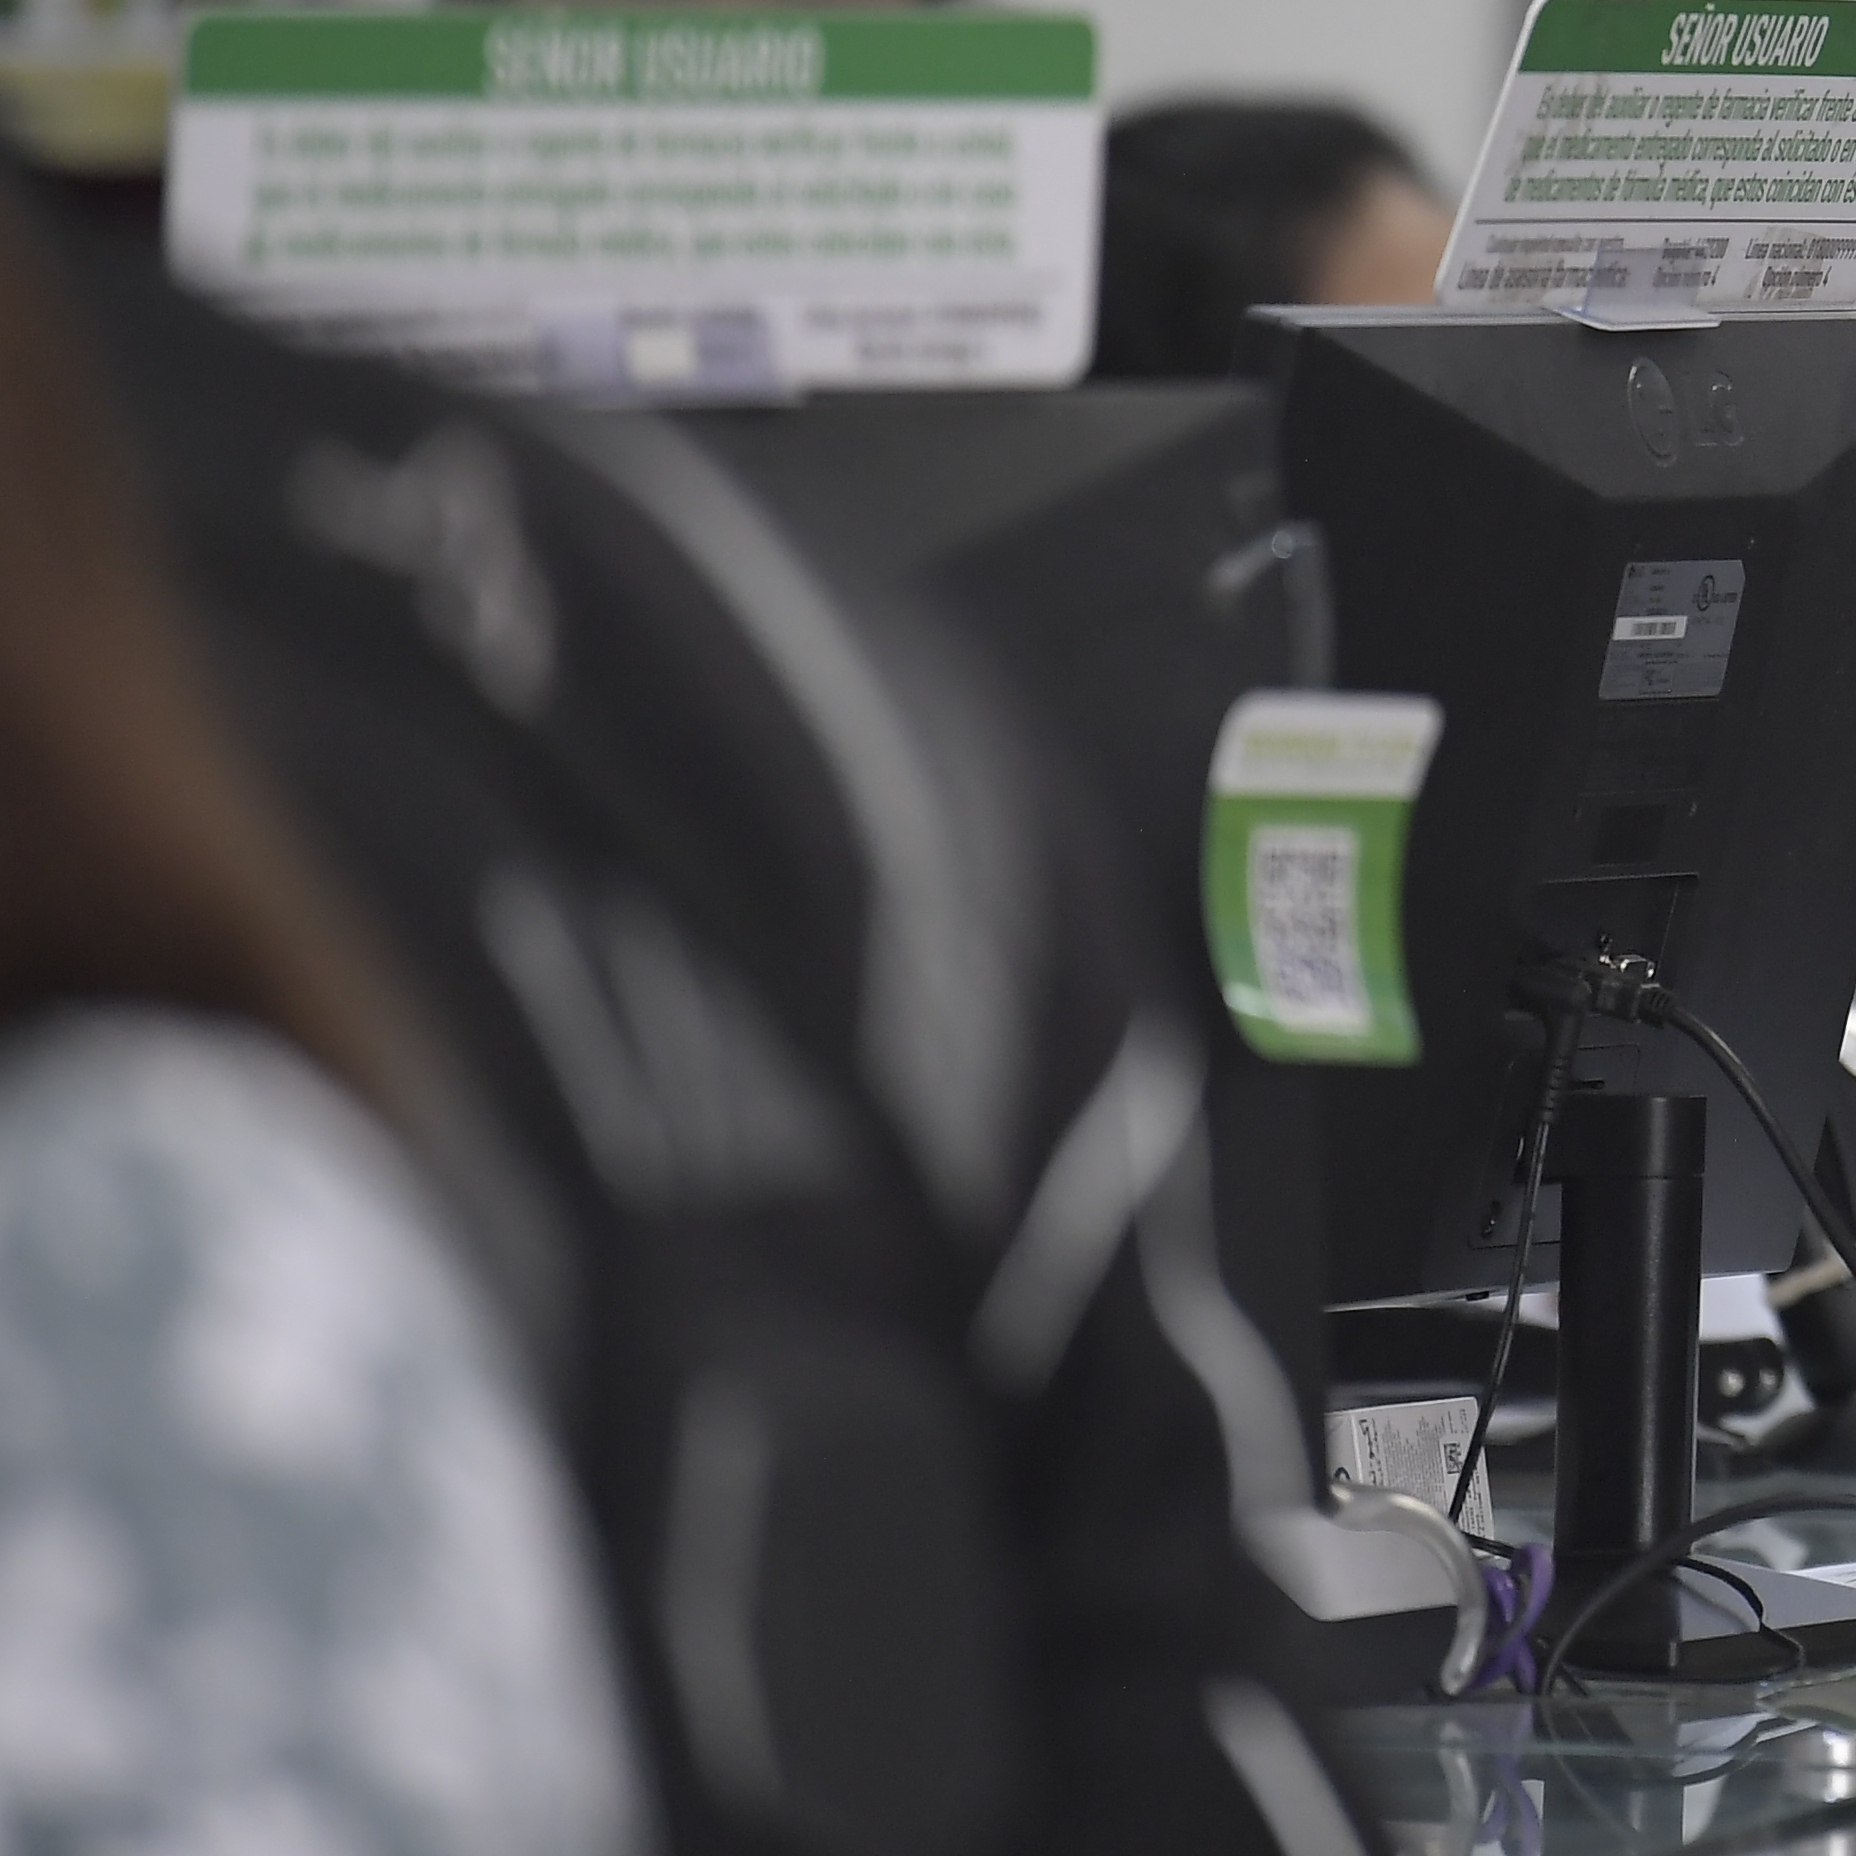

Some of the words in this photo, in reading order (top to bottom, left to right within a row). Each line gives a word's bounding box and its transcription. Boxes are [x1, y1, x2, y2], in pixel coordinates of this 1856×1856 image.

[1661, 2, 1738, 66] SEÑOR
[1731, 12, 1830, 68] USUARIO
[1701, 88, 1720, 120] de
[1716, 87, 1772, 120] farmacia
[1769, 87, 1820, 122] verificar
[1815, 89, 1855, 123] frente
[1761, 129, 1781, 162] al
[1774, 129, 1833, 163] solicitado
[1830, 138, 1843, 163] o
[1602, 170, 1621, 202] de
[1710, 177, 1736, 210] que
[1733, 172, 1768, 203] estos
[1765, 170, 1823, 204] coincidan
[1819, 179, 1846, 204] con
[1822, 264, 1833, 287] 4
